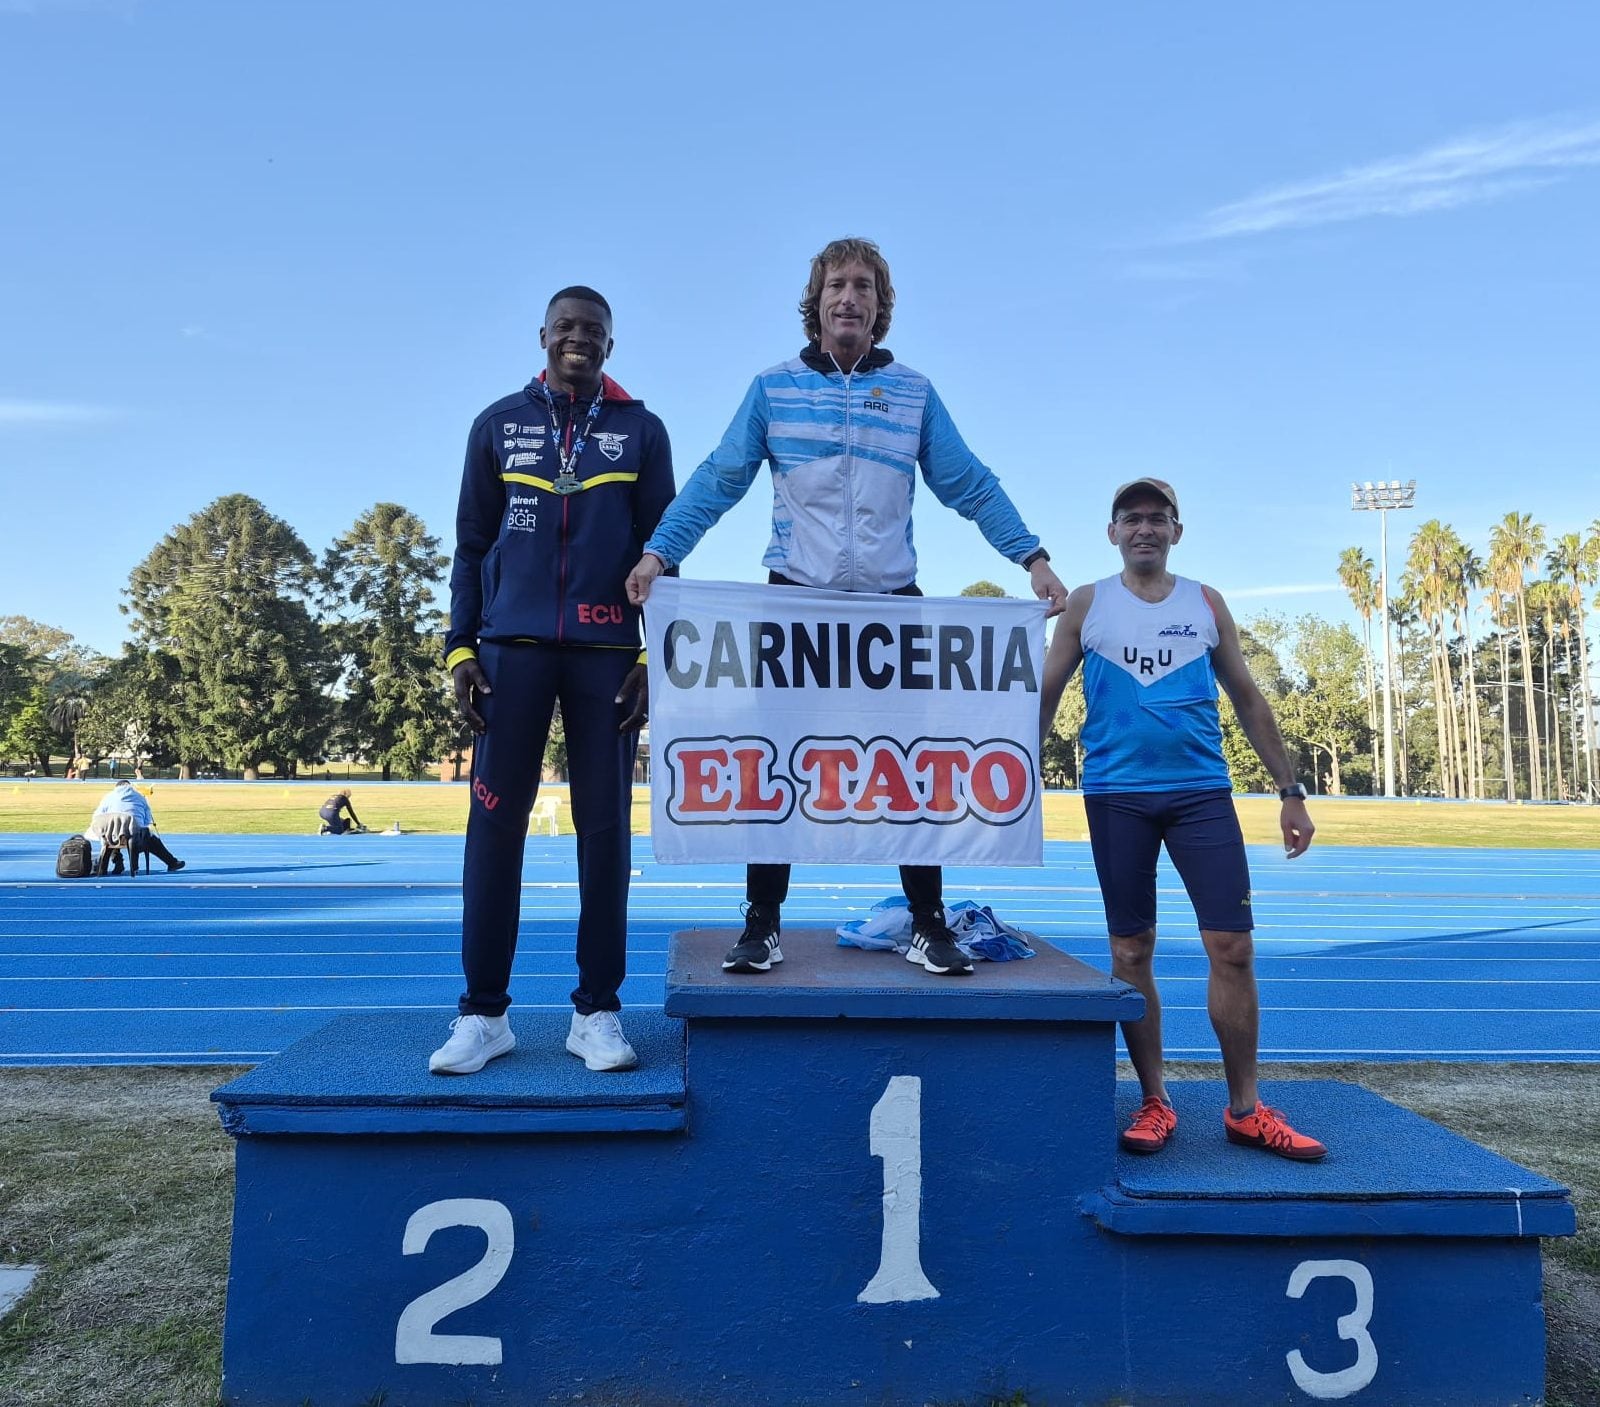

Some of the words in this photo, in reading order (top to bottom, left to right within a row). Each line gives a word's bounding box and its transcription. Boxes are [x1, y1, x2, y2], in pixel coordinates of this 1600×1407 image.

[864, 401, 889, 413] ARG
[507, 513, 537, 527] BGR
[577, 604, 624, 625] ECU
[663, 620, 1038, 693] CARNICERIA
[1124, 646, 1172, 675] URU
[472, 776, 501, 811] ECU
[671, 742, 790, 818] EL
[795, 742, 1031, 819] TATO
[856, 1074, 941, 1304] 1
[394, 1198, 515, 1365] 2
[1285, 1258, 1379, 1399] 3
